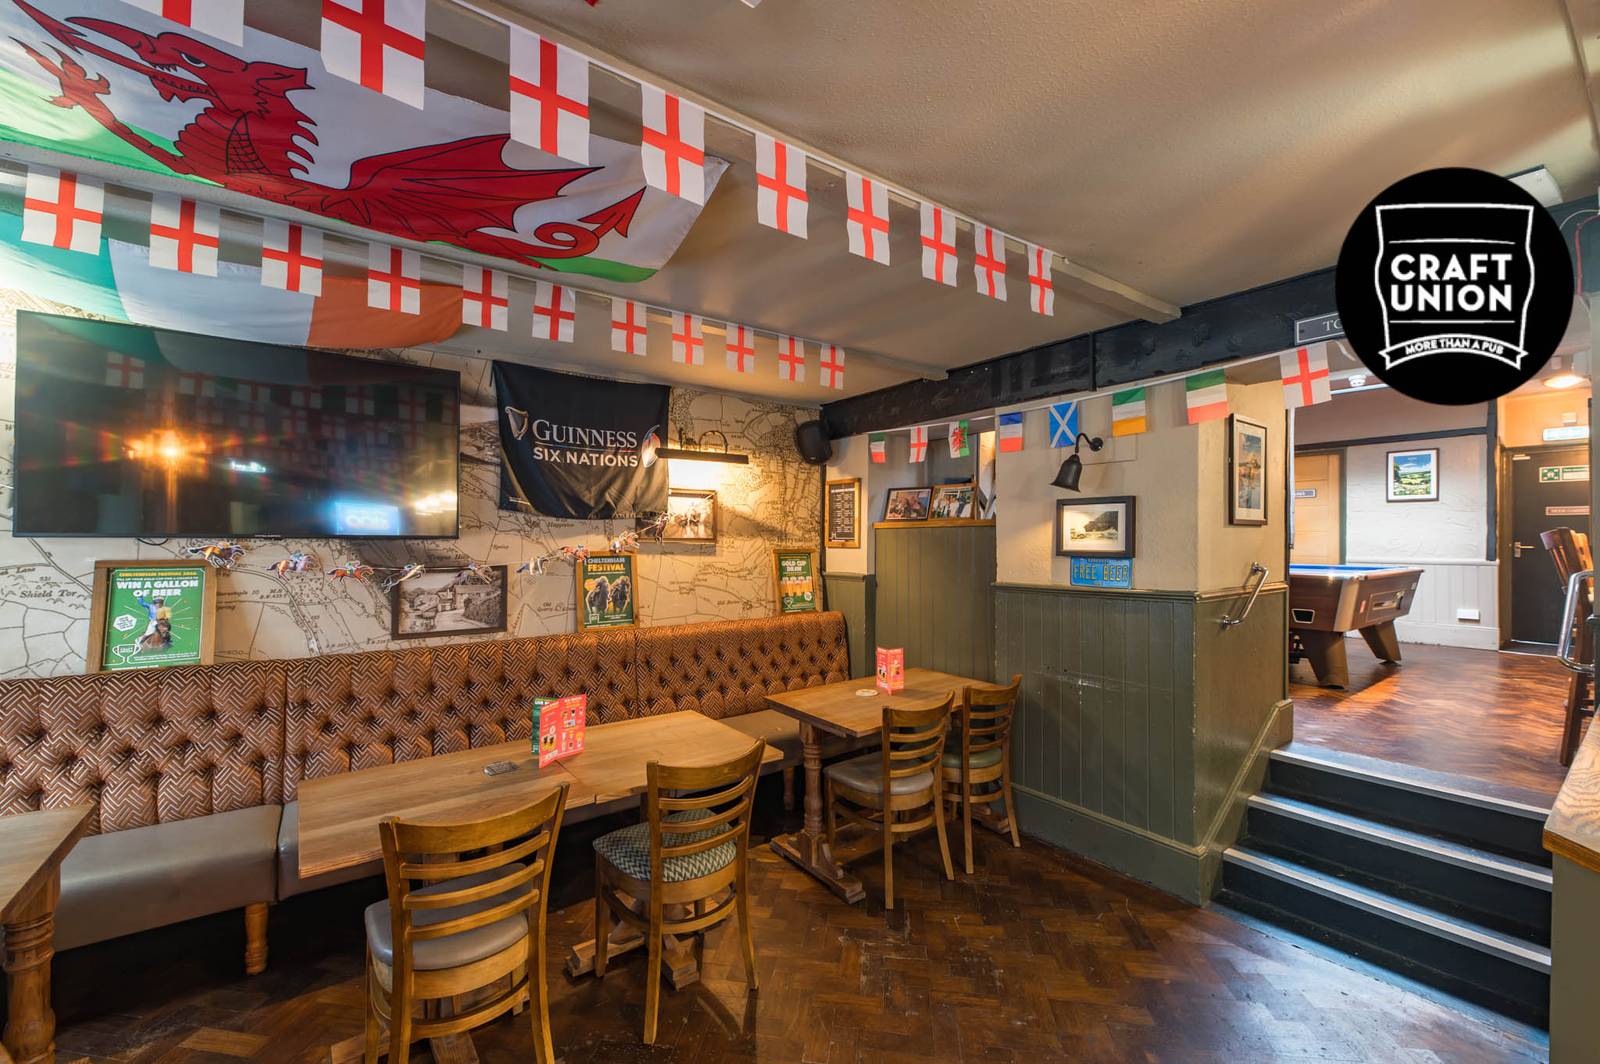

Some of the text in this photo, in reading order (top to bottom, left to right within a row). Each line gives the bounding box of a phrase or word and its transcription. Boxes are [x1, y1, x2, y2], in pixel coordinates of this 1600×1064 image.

[532, 419, 638, 448] GUINNESS
[532, 447, 638, 468] SIX NATIONS
[587, 563, 625, 572] FESTIVAL
[1073, 563, 1128, 582] FREE BEER
[116, 581, 142, 589] WIN
[153, 580, 199, 588] GALLON
[19, 589, 78, 599] Shield Tor
[133, 588, 181, 597] OF BEER
